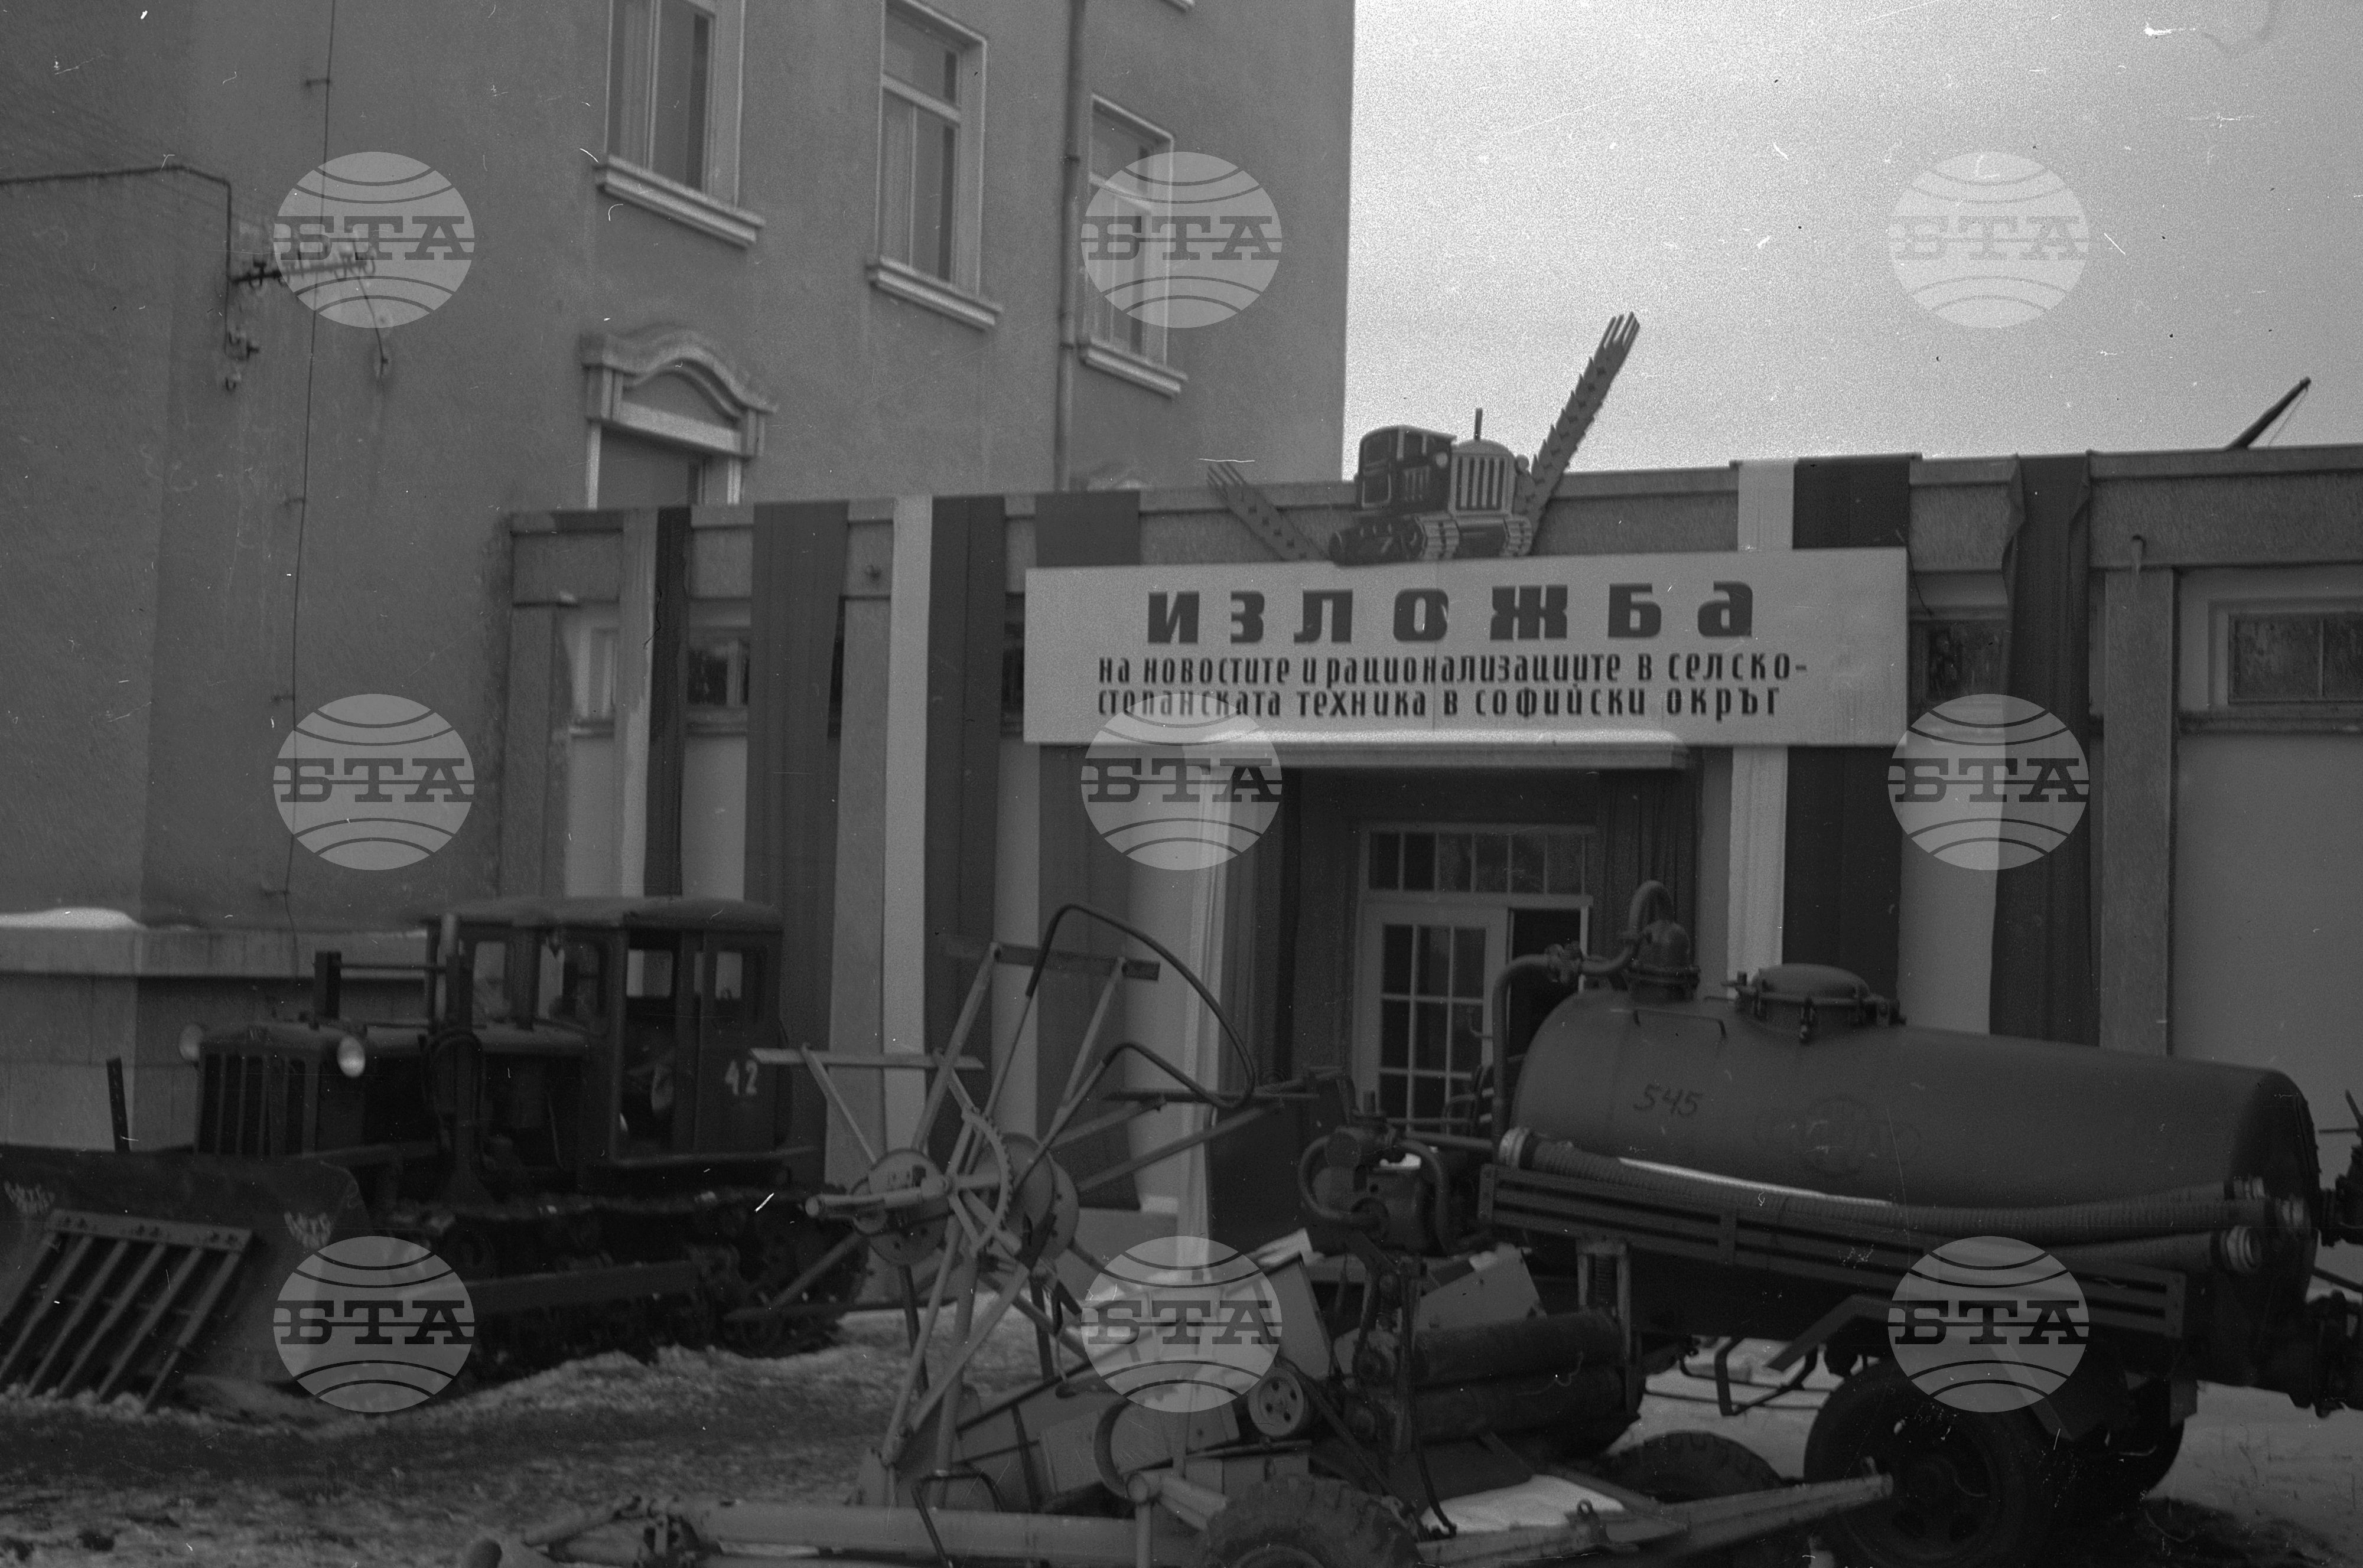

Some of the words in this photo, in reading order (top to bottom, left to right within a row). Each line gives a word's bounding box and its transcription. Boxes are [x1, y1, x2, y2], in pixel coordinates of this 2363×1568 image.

[1099, 657, 1131, 684] на
[1144, 656, 1290, 684] новостите
[1302, 657, 1317, 683] и
[1327, 653, 1620, 689] рационализациите
[1638, 654, 1652, 680] в
[1668, 652, 1807, 682] селско-
[1098, 690, 1281, 717] стопанската
[1297, 689, 1426, 717] техника
[1443, 689, 1458, 716] в
[1476, 683, 1645, 718] софийски
[1666, 687, 1779, 721] окръг
[1633, 1083, 1703, 1117] 545
